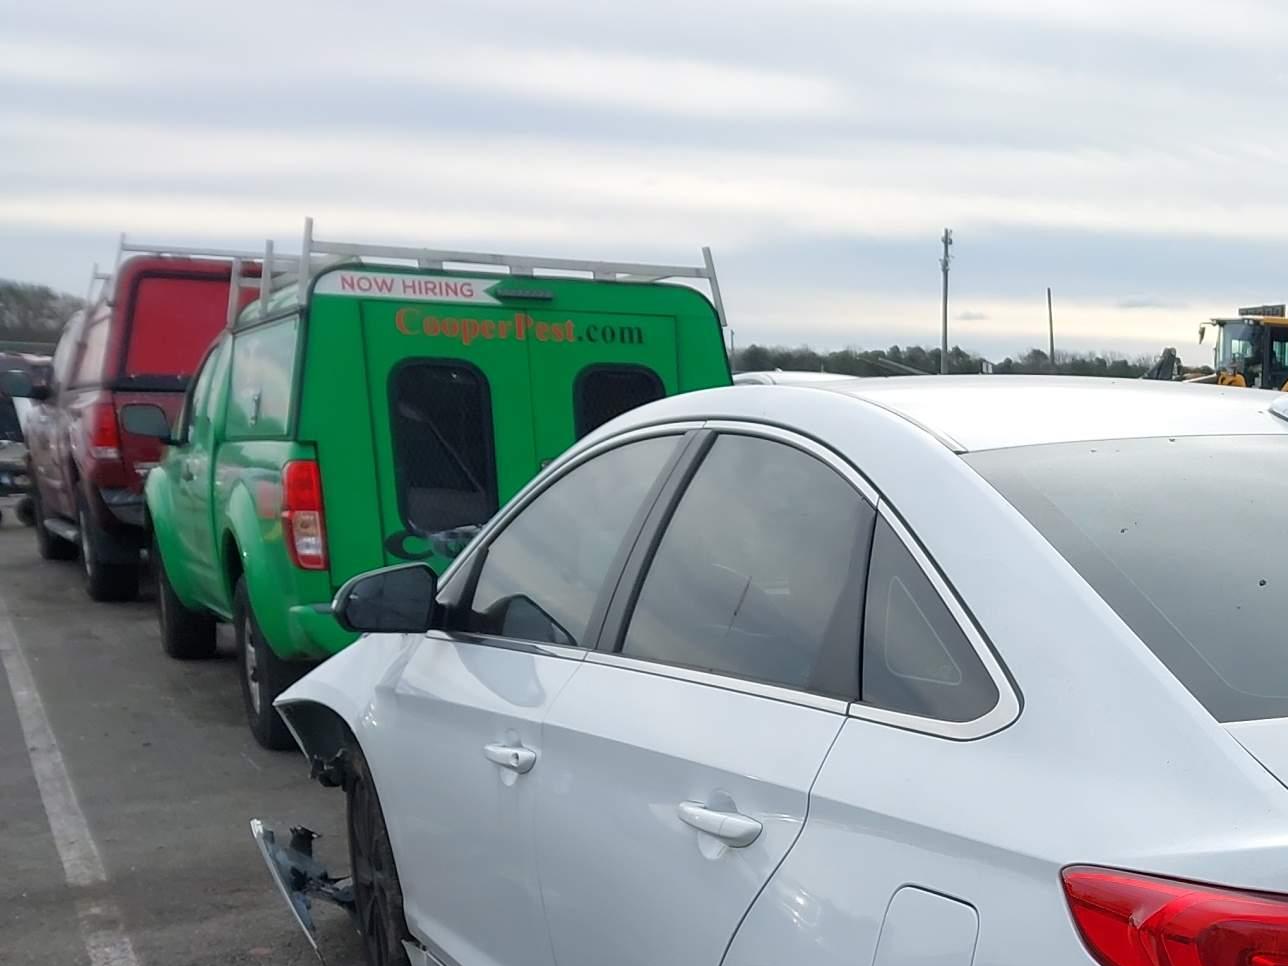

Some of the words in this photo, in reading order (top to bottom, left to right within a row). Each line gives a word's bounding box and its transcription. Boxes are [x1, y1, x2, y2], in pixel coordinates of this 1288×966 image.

[340, 275, 394, 294] NOW
[401, 279, 475, 298] HIRING
[394, 307, 645, 345] CooperPest.com
